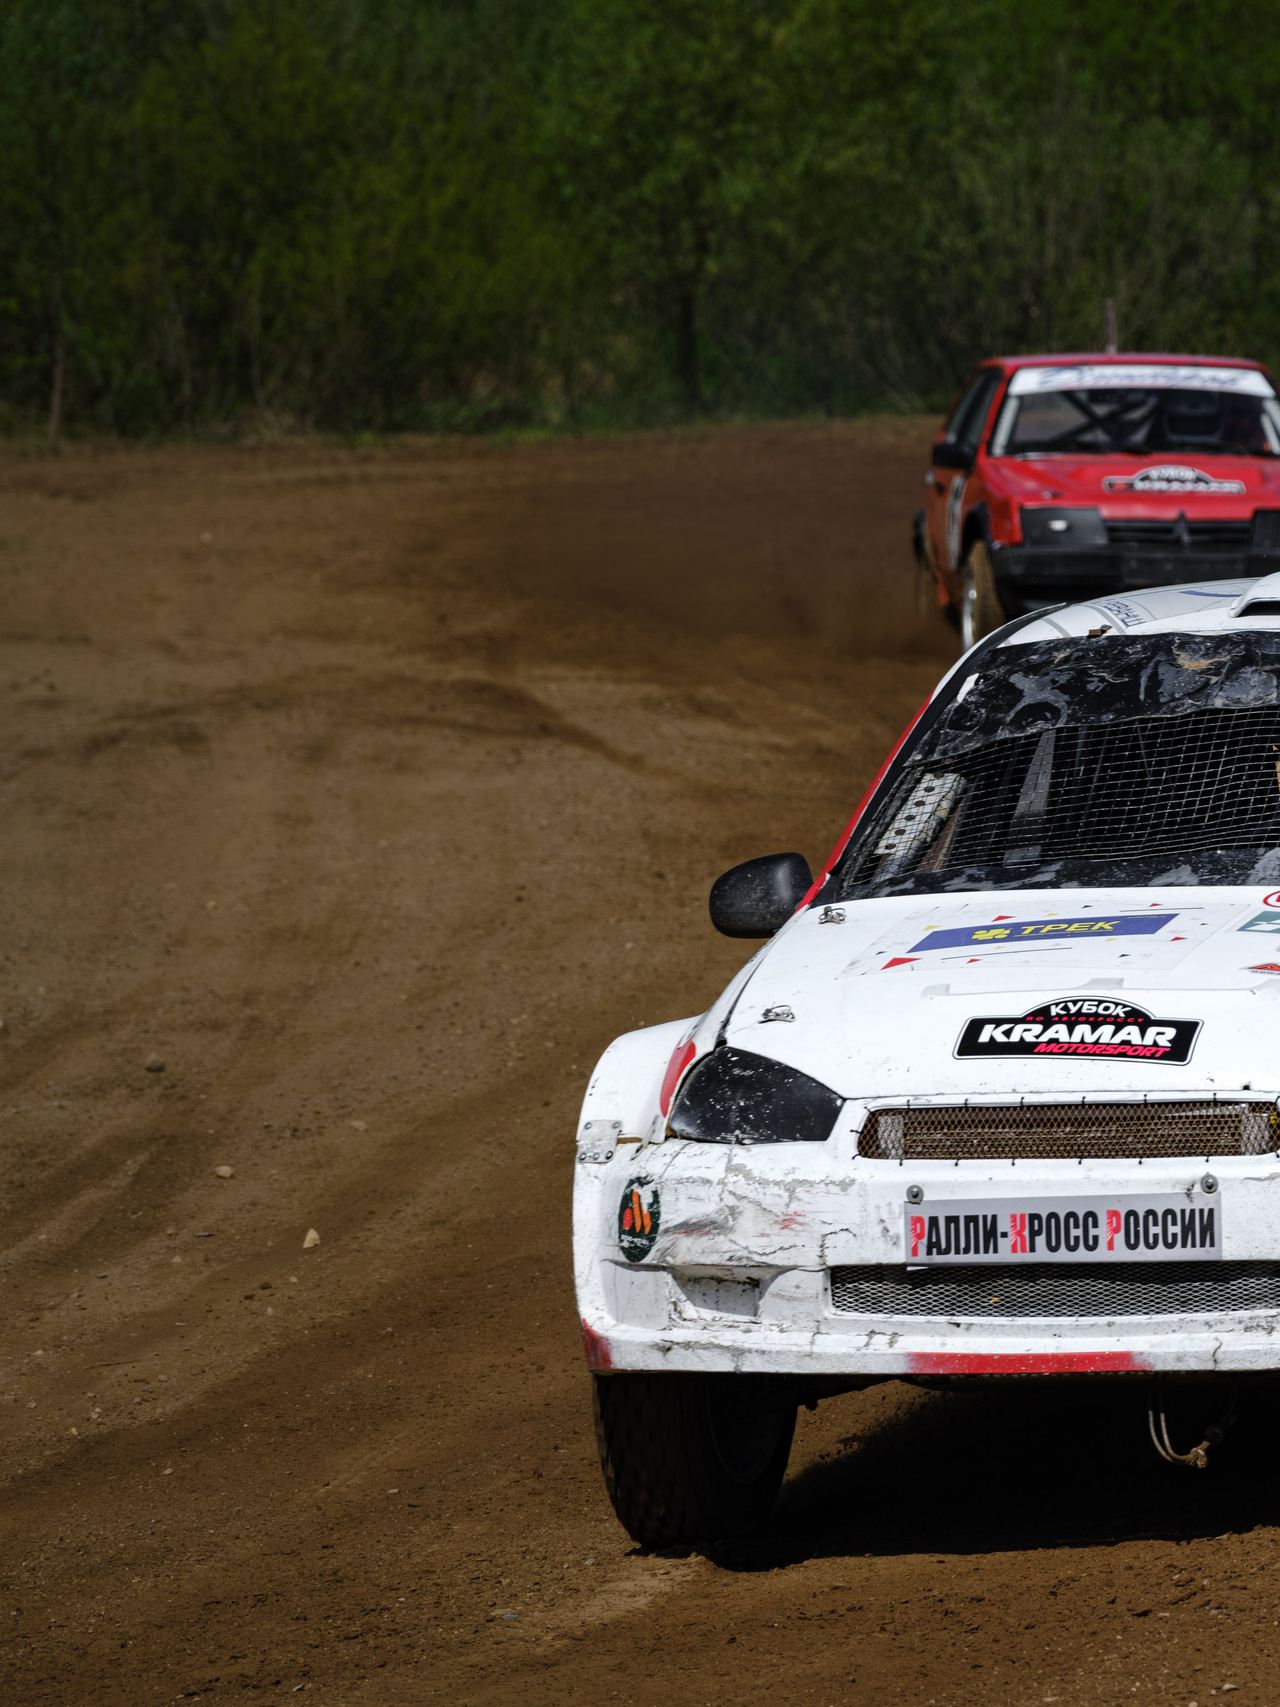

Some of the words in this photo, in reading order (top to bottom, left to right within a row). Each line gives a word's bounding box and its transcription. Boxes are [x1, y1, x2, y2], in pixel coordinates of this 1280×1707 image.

[1020, 920, 1122, 935] ТРЕК
[1051, 1001, 1132, 1017] КУБОК
[977, 1024, 1178, 1047] KRAMAR
[1033, 1043, 1171, 1058] MOTORSPORT
[910, 1210, 1100, 1257] РАЛЛИ-КРОСС
[1106, 1207, 1216, 1251] РОССИИ
